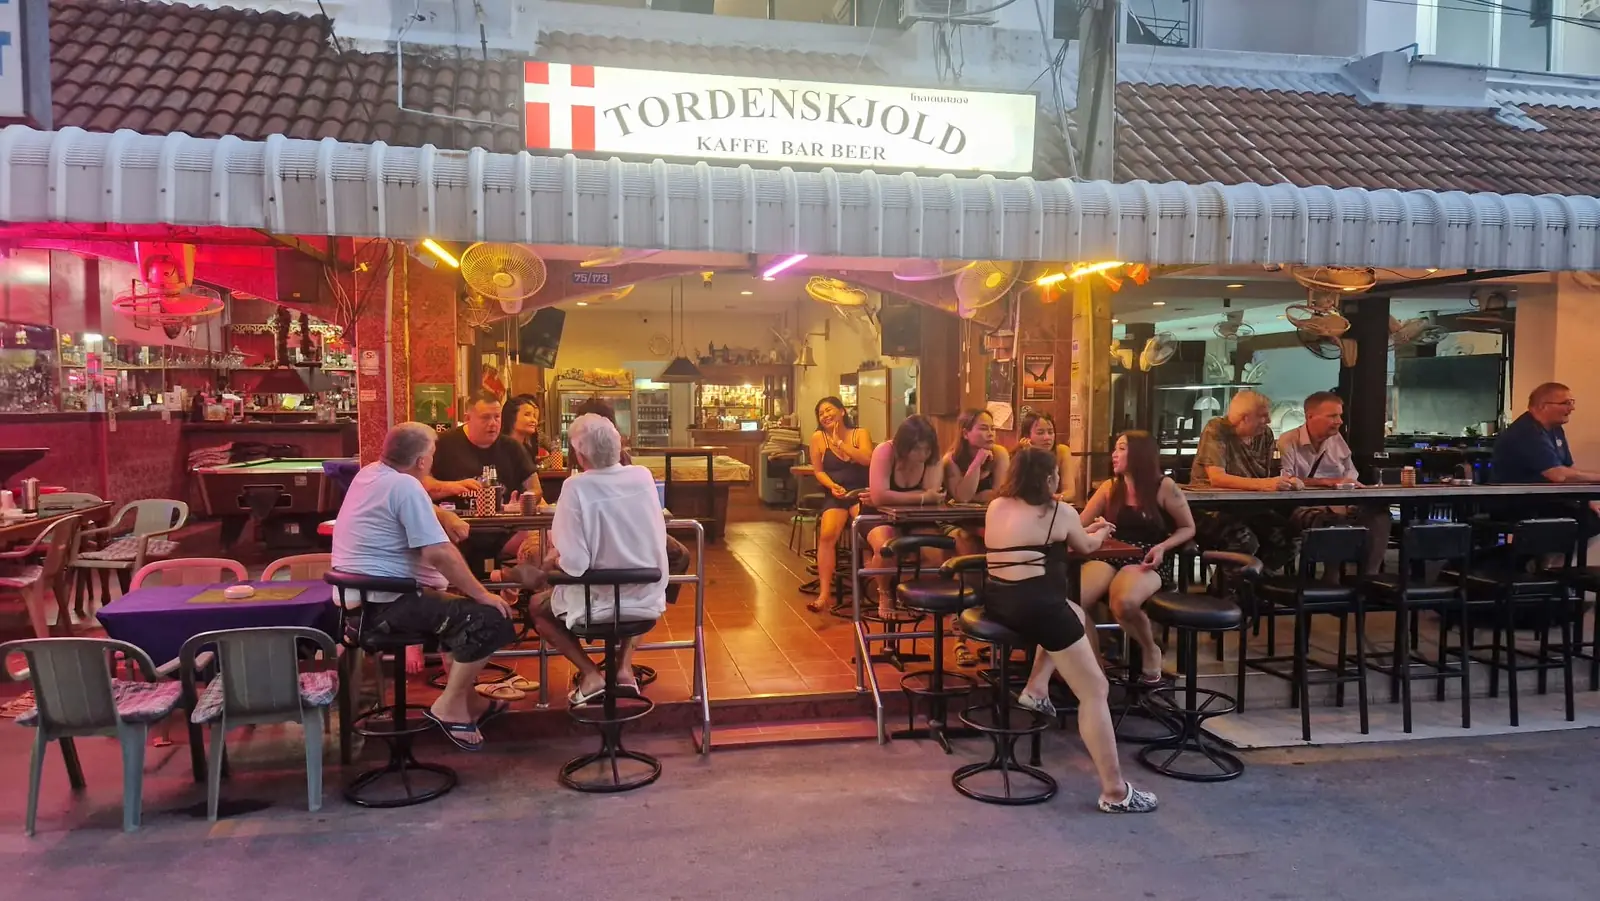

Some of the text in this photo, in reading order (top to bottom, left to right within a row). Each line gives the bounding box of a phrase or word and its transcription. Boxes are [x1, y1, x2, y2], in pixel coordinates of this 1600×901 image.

[603, 87, 967, 155] TORDENSKJOLD
[697, 135, 887, 160] KAFFE BAR BEER
[574, 272, 609, 283] 75/173
